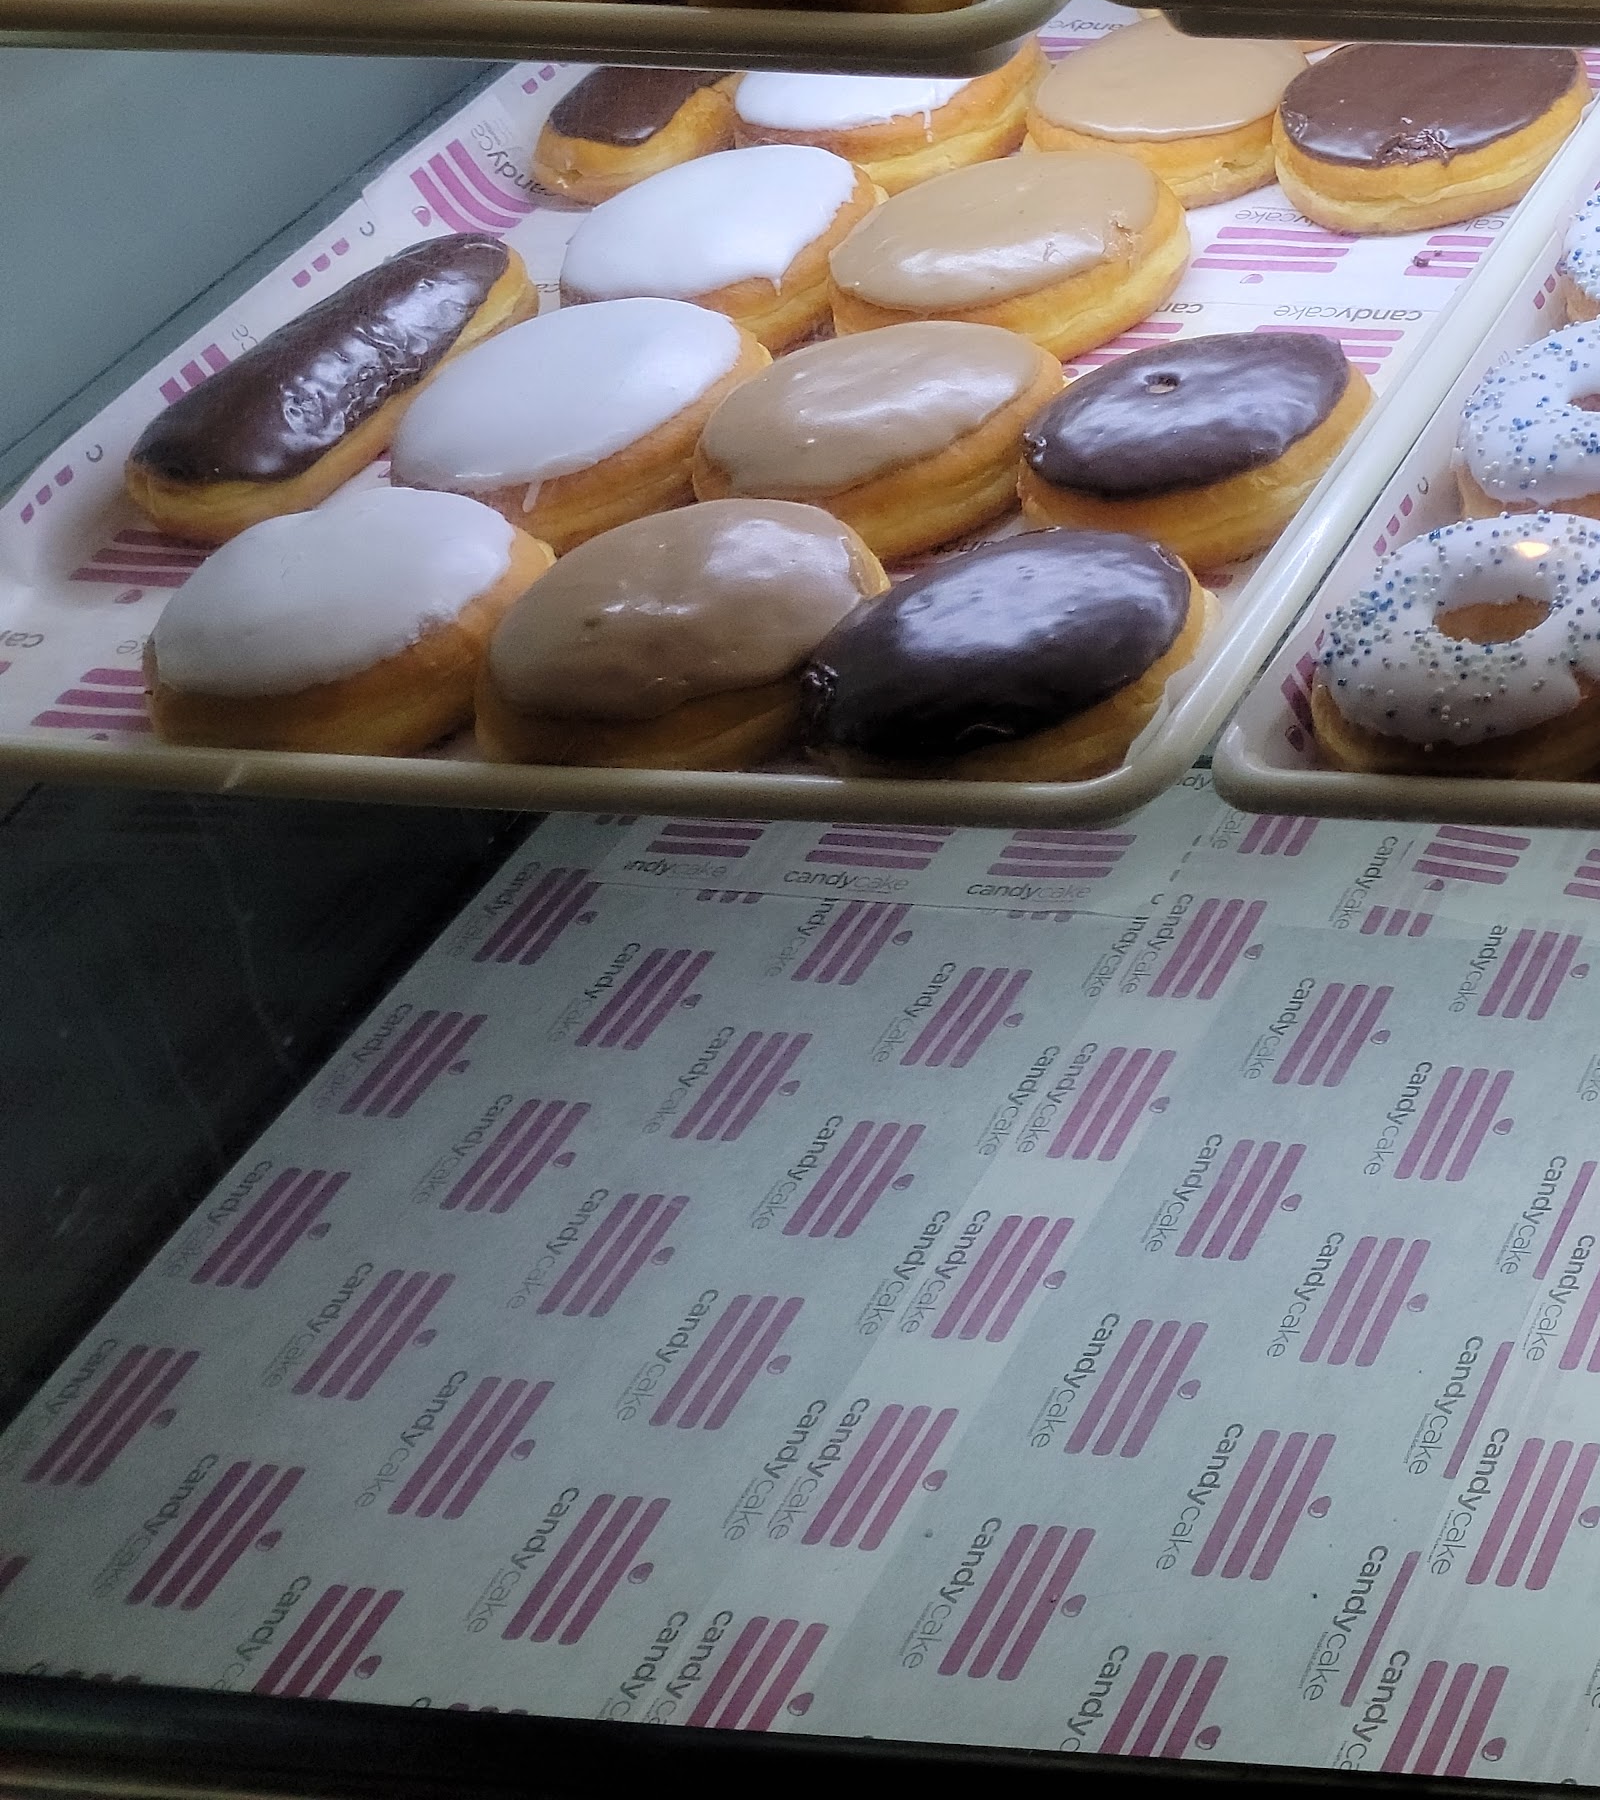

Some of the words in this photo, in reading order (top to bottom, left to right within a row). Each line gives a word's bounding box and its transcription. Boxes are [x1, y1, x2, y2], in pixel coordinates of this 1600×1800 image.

[1273, 304, 1423, 322] candycake
[624, 858, 727, 877] ndycake
[783, 868, 909, 892] candycake
[967, 881, 1091, 901] candycake
[1337, 835, 1398, 931] candycake
[1123, 894, 1194, 995] candycake
[872, 962, 957, 1063] candycake
[1247, 977, 1316, 1080] candycake
[643, 1027, 734, 1134] candycake
[979, 1046, 1060, 1156] candycake
[1016, 1042, 1098, 1154] candycake
[1363, 1061, 1433, 1176] candycake
[417, 1093, 514, 1205] candycake
[751, 1114, 844, 1230] candycake
[1145, 1133, 1223, 1253] candycake
[505, 1189, 609, 1310] candycake
[860, 1211, 950, 1336] candycake
[901, 1209, 991, 1334] candycake
[1501, 1155, 1568, 1275] candycake
[1266, 1231, 1345, 1358] candycake
[1526, 1235, 1596, 1362] candycake
[616, 1289, 719, 1422] candycake
[1031, 1312, 1121, 1448] candycake
[1408, 1336, 1484, 1475] candycake
[355, 1370, 468, 1508] candycake
[723, 1399, 828, 1541] candycake
[767, 1397, 871, 1540] candycake
[1155, 1423, 1245, 1571] candycake
[468, 1486, 580, 1633] candycake
[1431, 1428, 1510, 1575] candycake
[901, 1517, 1002, 1669] candycake
[1303, 1545, 1389, 1701] candycake
